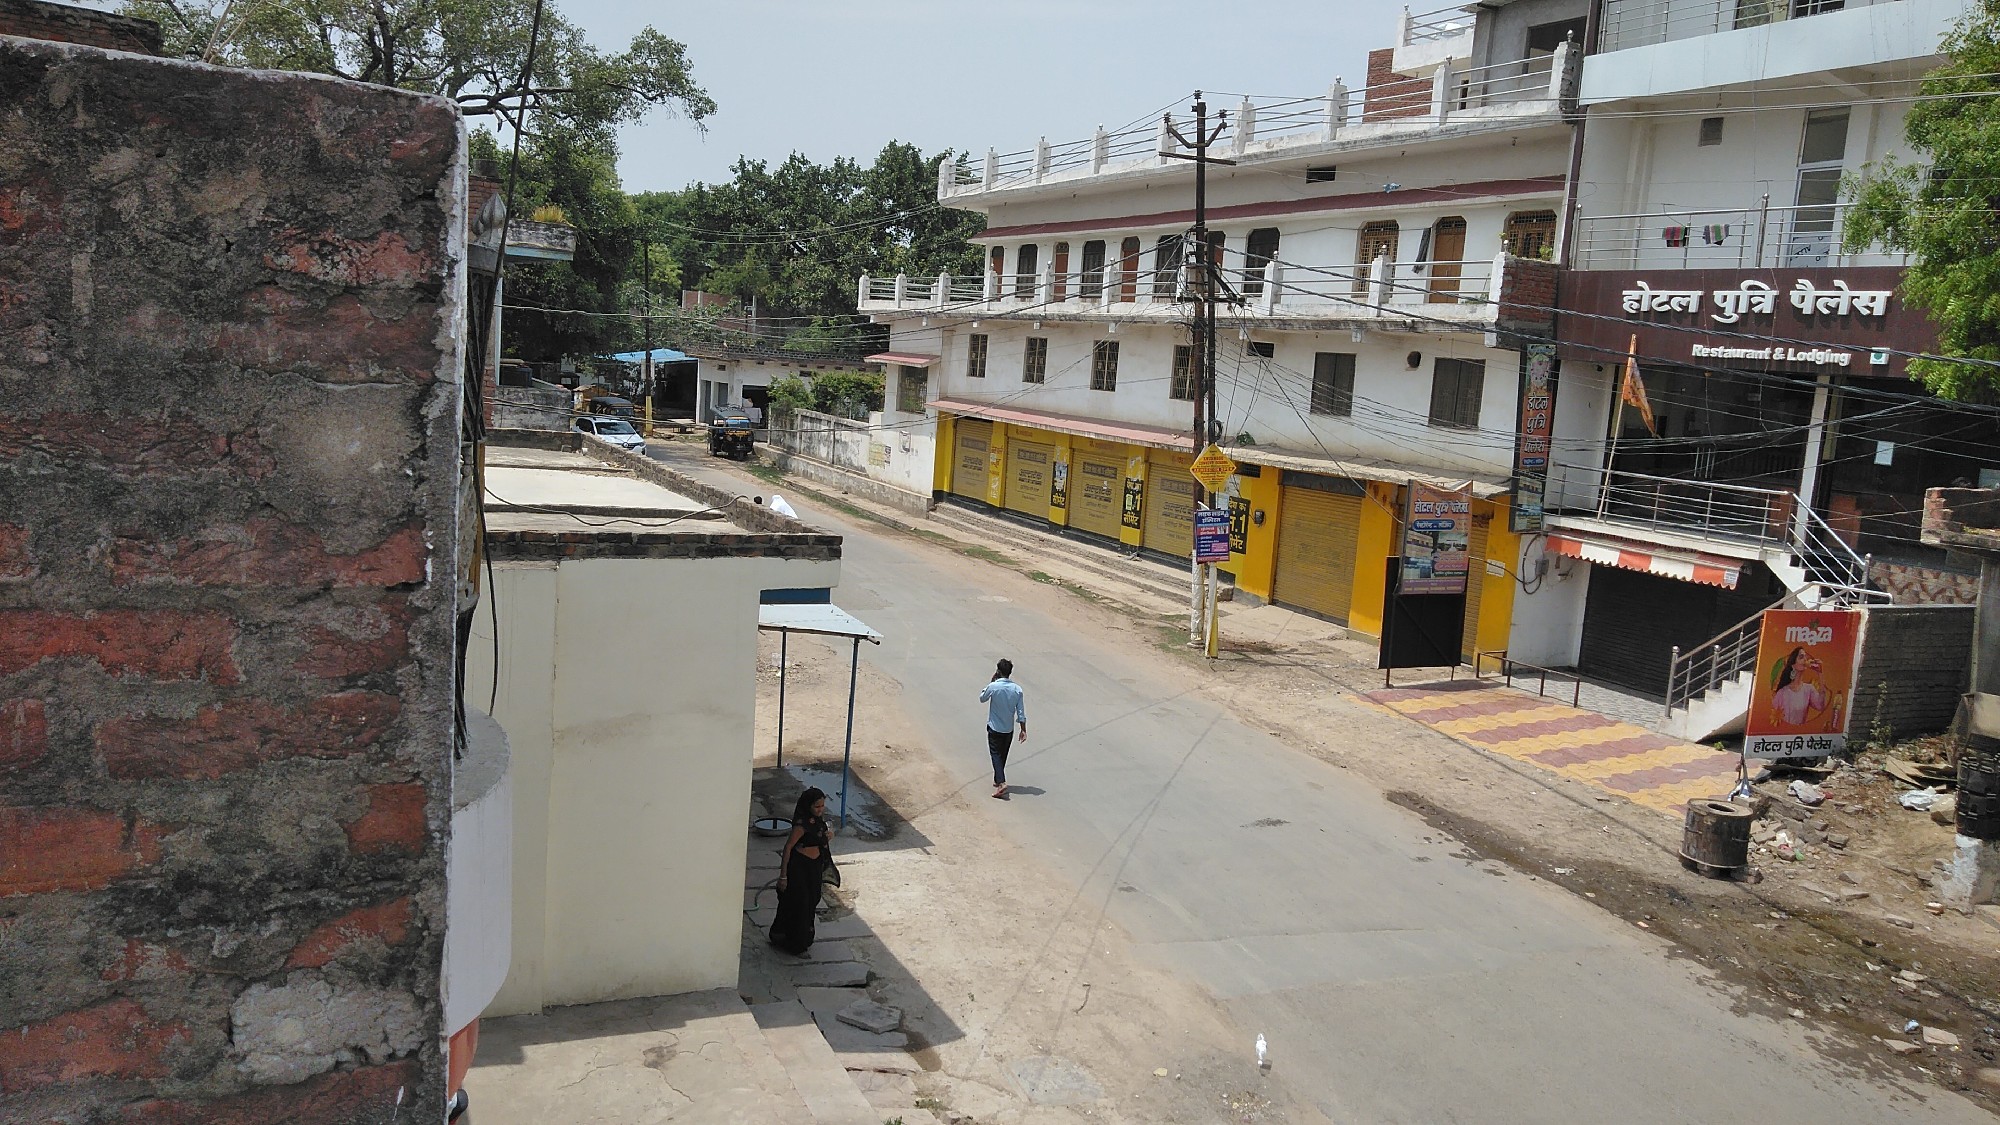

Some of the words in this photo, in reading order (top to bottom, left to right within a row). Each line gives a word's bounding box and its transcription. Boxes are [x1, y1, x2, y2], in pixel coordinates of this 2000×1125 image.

[1622, 281, 1703, 314] होटल
[1711, 280, 1779, 323] पुत्रि
[1790, 279, 1892, 316] पैलेस
[1692, 344, 1772, 359] Restaurant
[1773, 347, 1786, 360] &
[1787, 348, 1852, 366] Lodging
[1527, 392, 1549, 411] होटल
[1785, 626, 1833, 646] maaza
[1753, 738, 1783, 753] होटल
[1784, 736, 1805, 755] पुत्रि
[1806, 736, 1832, 750] पैलेस
